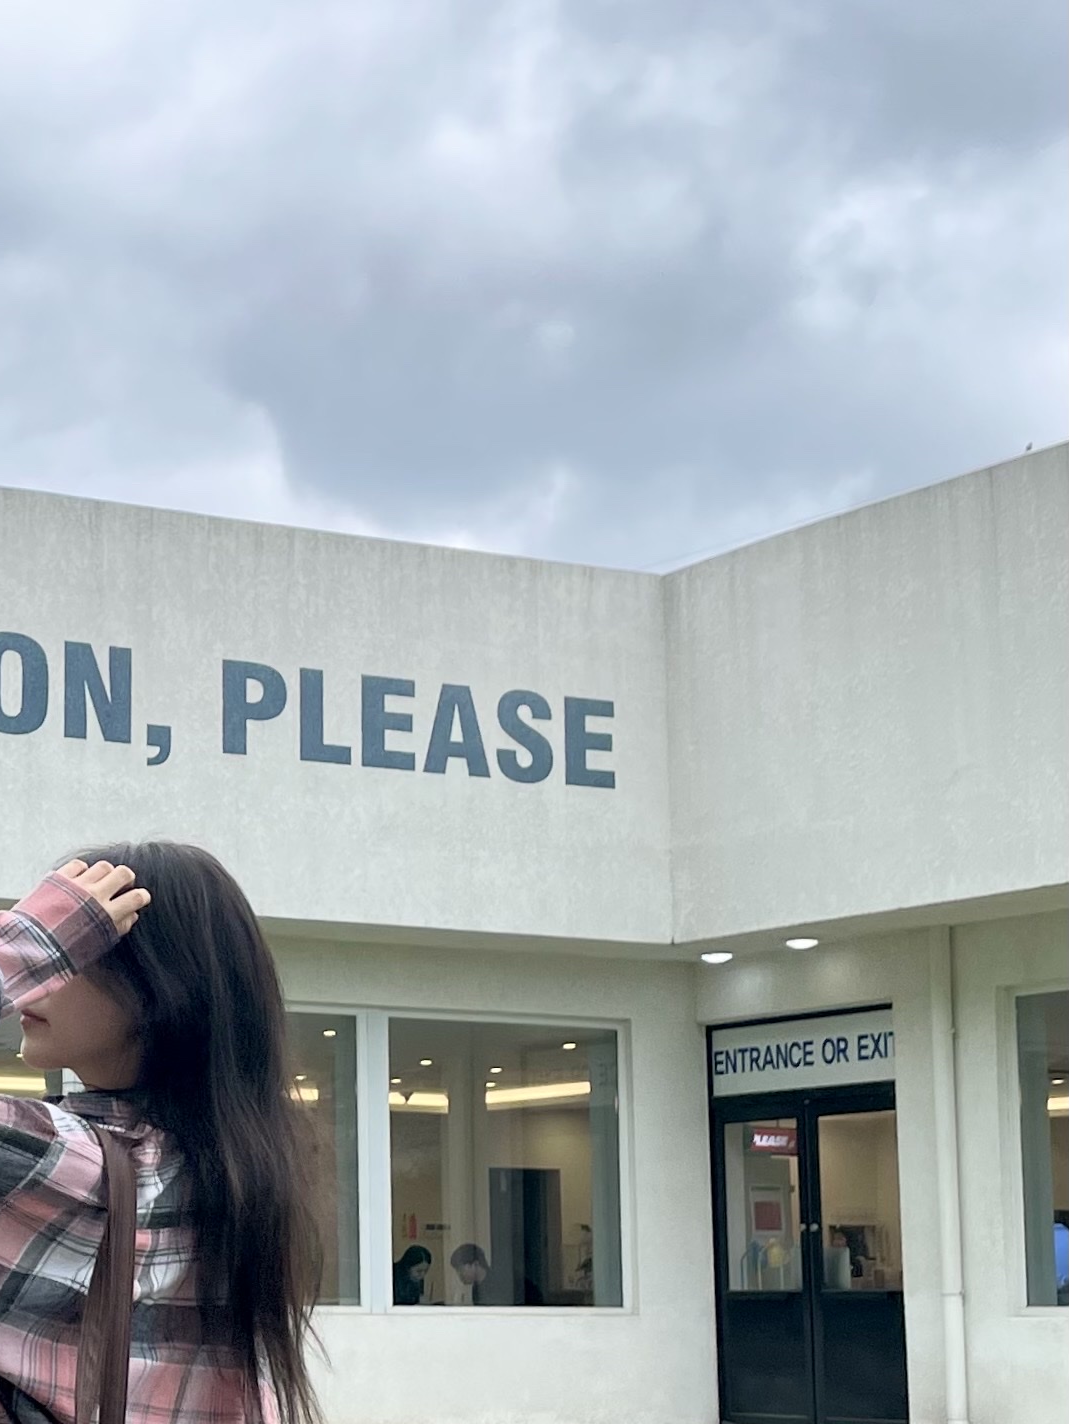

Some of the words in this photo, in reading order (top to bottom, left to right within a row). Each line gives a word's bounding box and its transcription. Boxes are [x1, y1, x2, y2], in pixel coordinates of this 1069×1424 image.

[222, 659, 616, 789] PLEASE
[713, 1040, 815, 1075] ENTRANCE
[821, 1037, 850, 1065] OR
